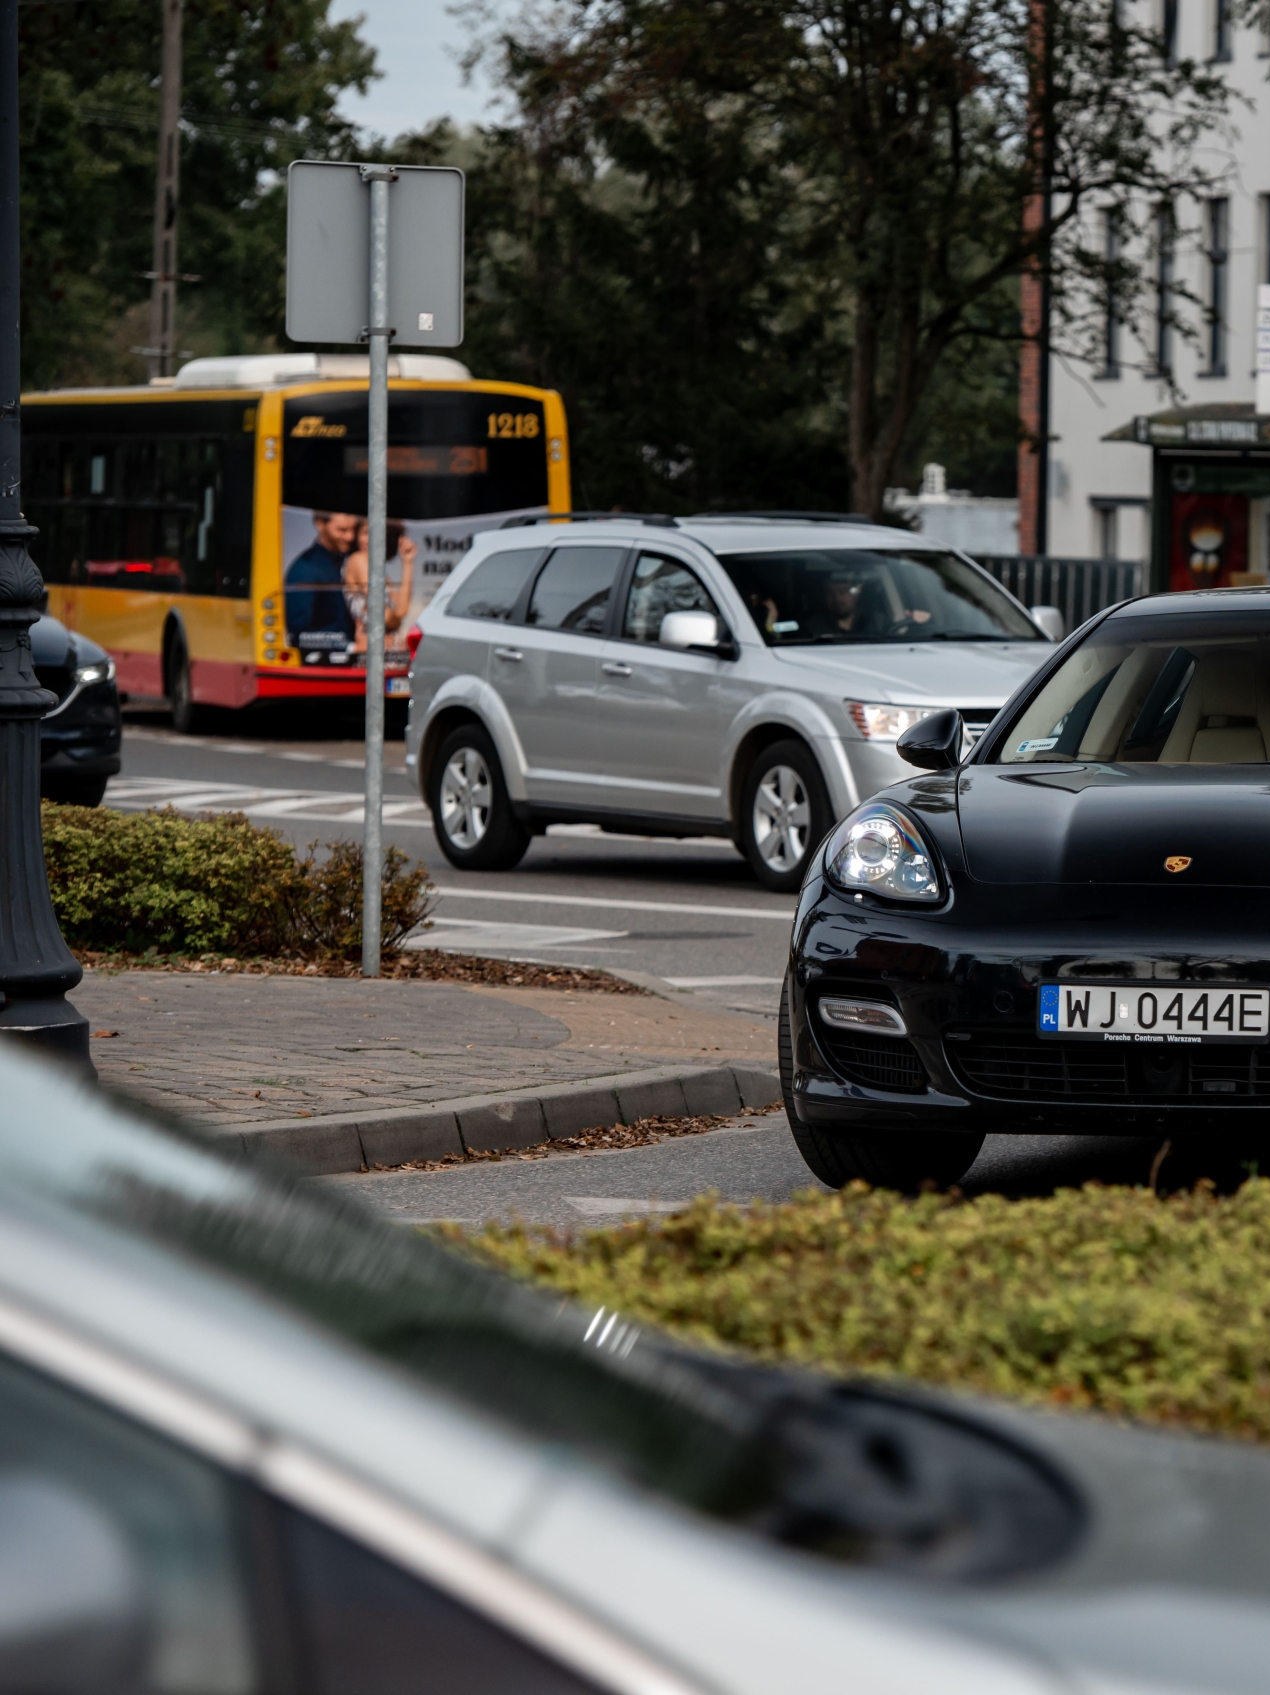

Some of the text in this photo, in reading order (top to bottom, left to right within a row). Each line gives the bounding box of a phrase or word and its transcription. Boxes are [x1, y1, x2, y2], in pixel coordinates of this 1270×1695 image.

[1043, 990, 1263, 1032] PL WJ 0444E
[1104, 1033, 1202, 1043] Porsche Centrum Warszawa
